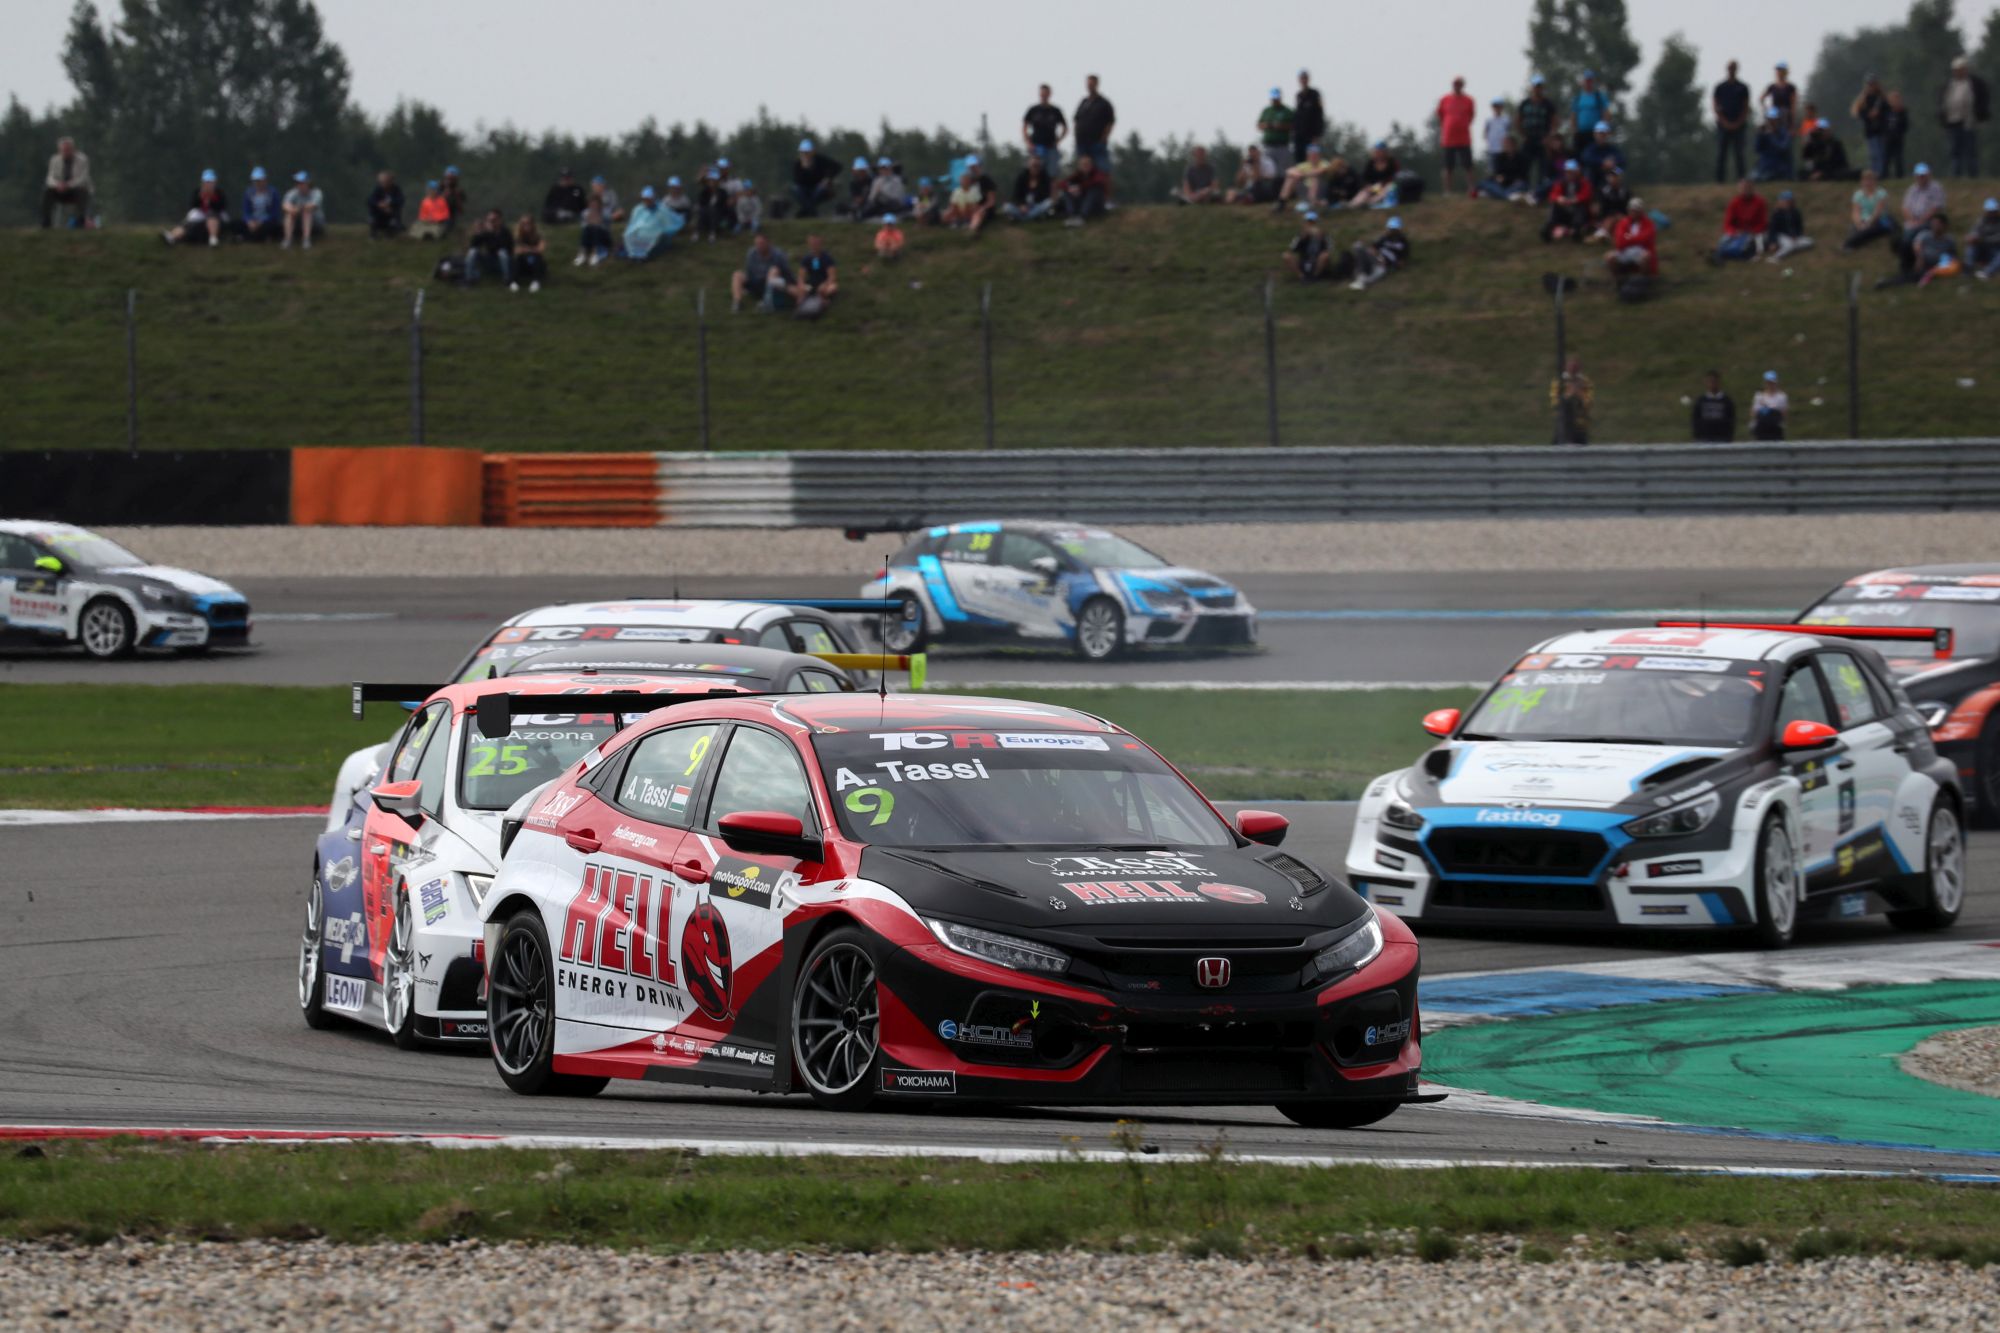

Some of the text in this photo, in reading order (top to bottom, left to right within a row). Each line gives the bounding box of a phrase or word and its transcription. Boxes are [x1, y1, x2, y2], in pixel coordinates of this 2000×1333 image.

[529, 626, 621, 642] TCR
[1551, 655, 1643, 670] TCR
[508, 730, 595, 742] Azcona
[869, 732, 1085, 751] TCR Europe
[466, 745, 529, 777] 25
[683, 735, 710, 776] 9
[836, 758, 990, 792] A. Tassi
[624, 775, 675, 810] A. Tassi
[845, 787, 895, 826] 9
[1475, 808, 1562, 827] fastlog
[713, 870, 771, 895] motorsport.com
[1051, 869, 1218, 878] www.tassi.hu
[1058, 880, 1200, 901] HELL
[558, 862, 679, 989] HELL
[328, 975, 364, 1009] LEONI
[558, 968, 685, 1013] ENERGY DRINK
[896, 1075, 951, 1088] YOKOHAMA
